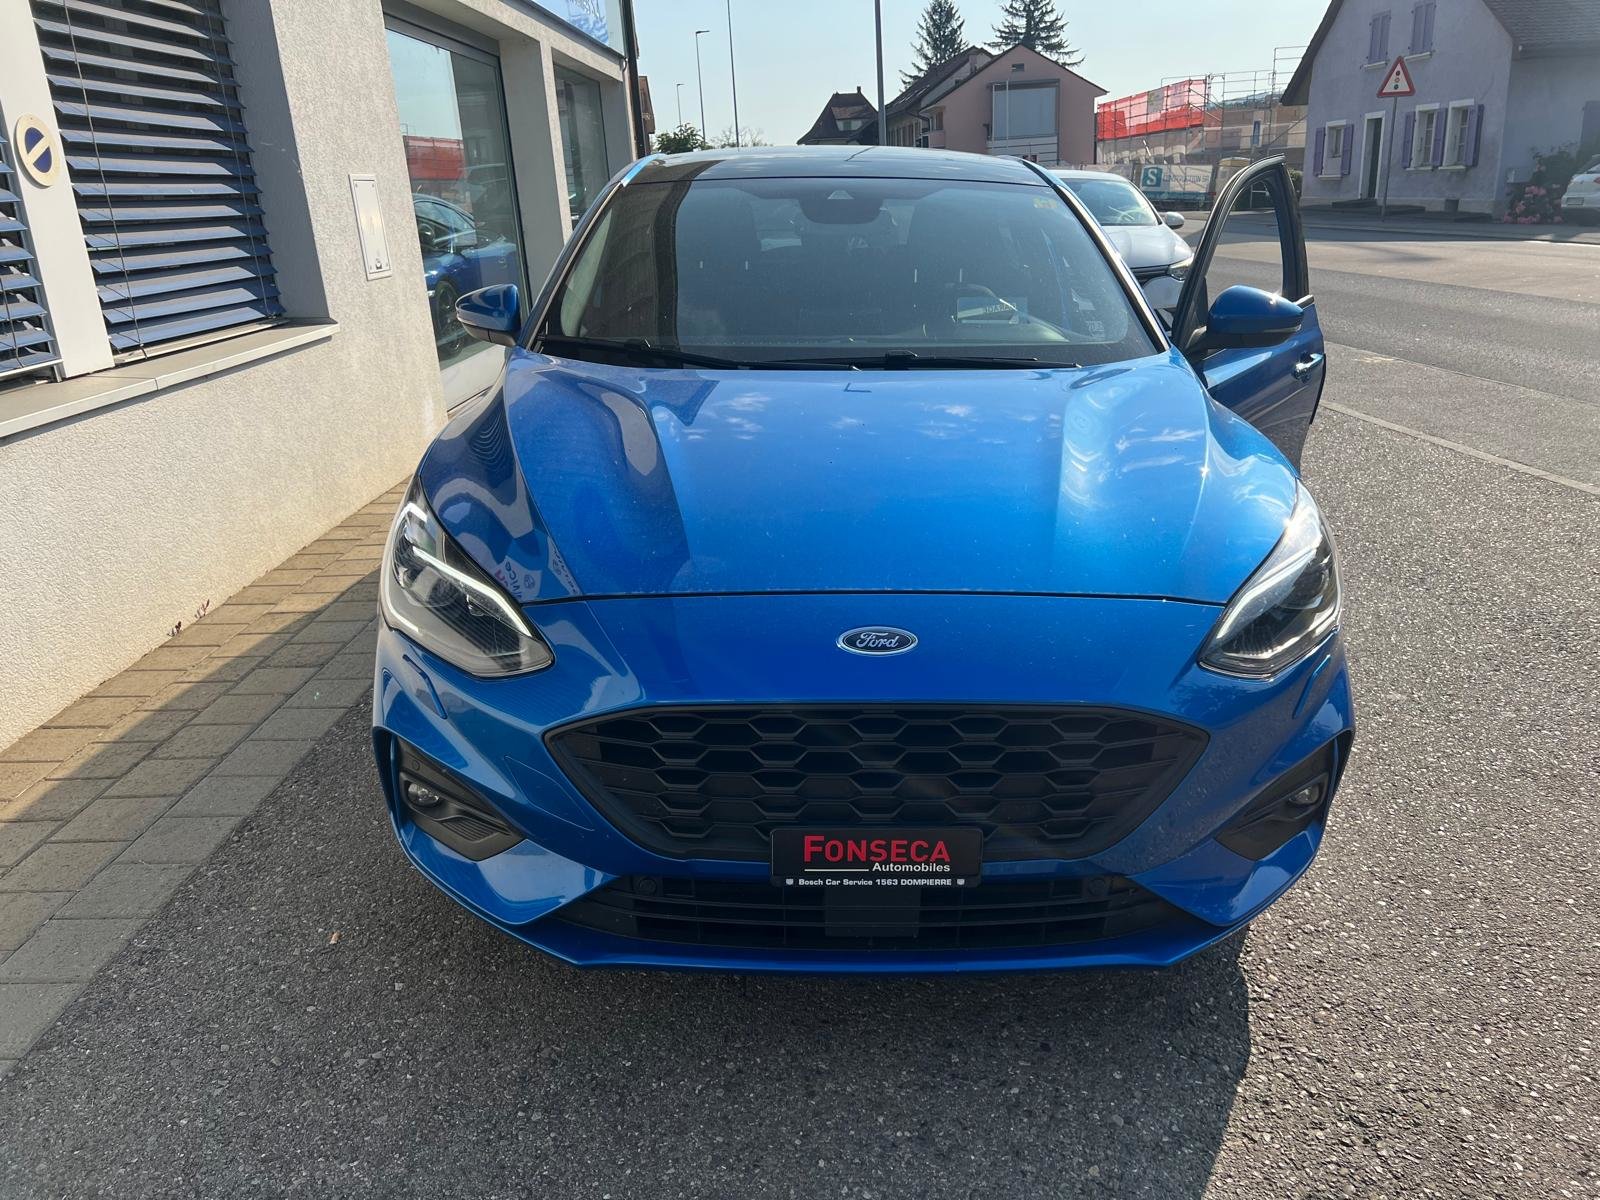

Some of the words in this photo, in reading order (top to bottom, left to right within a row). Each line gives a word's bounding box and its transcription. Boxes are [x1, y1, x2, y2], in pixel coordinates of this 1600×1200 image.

[855, 631, 900, 648] Ford
[803, 835, 951, 863] FONSECA
[871, 862, 951, 872] Automobiles
[798, 878, 823, 886] Bosch
[825, 878, 841, 886] Car
[842, 878, 873, 886] Service
[875, 878, 898, 886] 1563
[900, 878, 952, 886] DOMPIERRE
